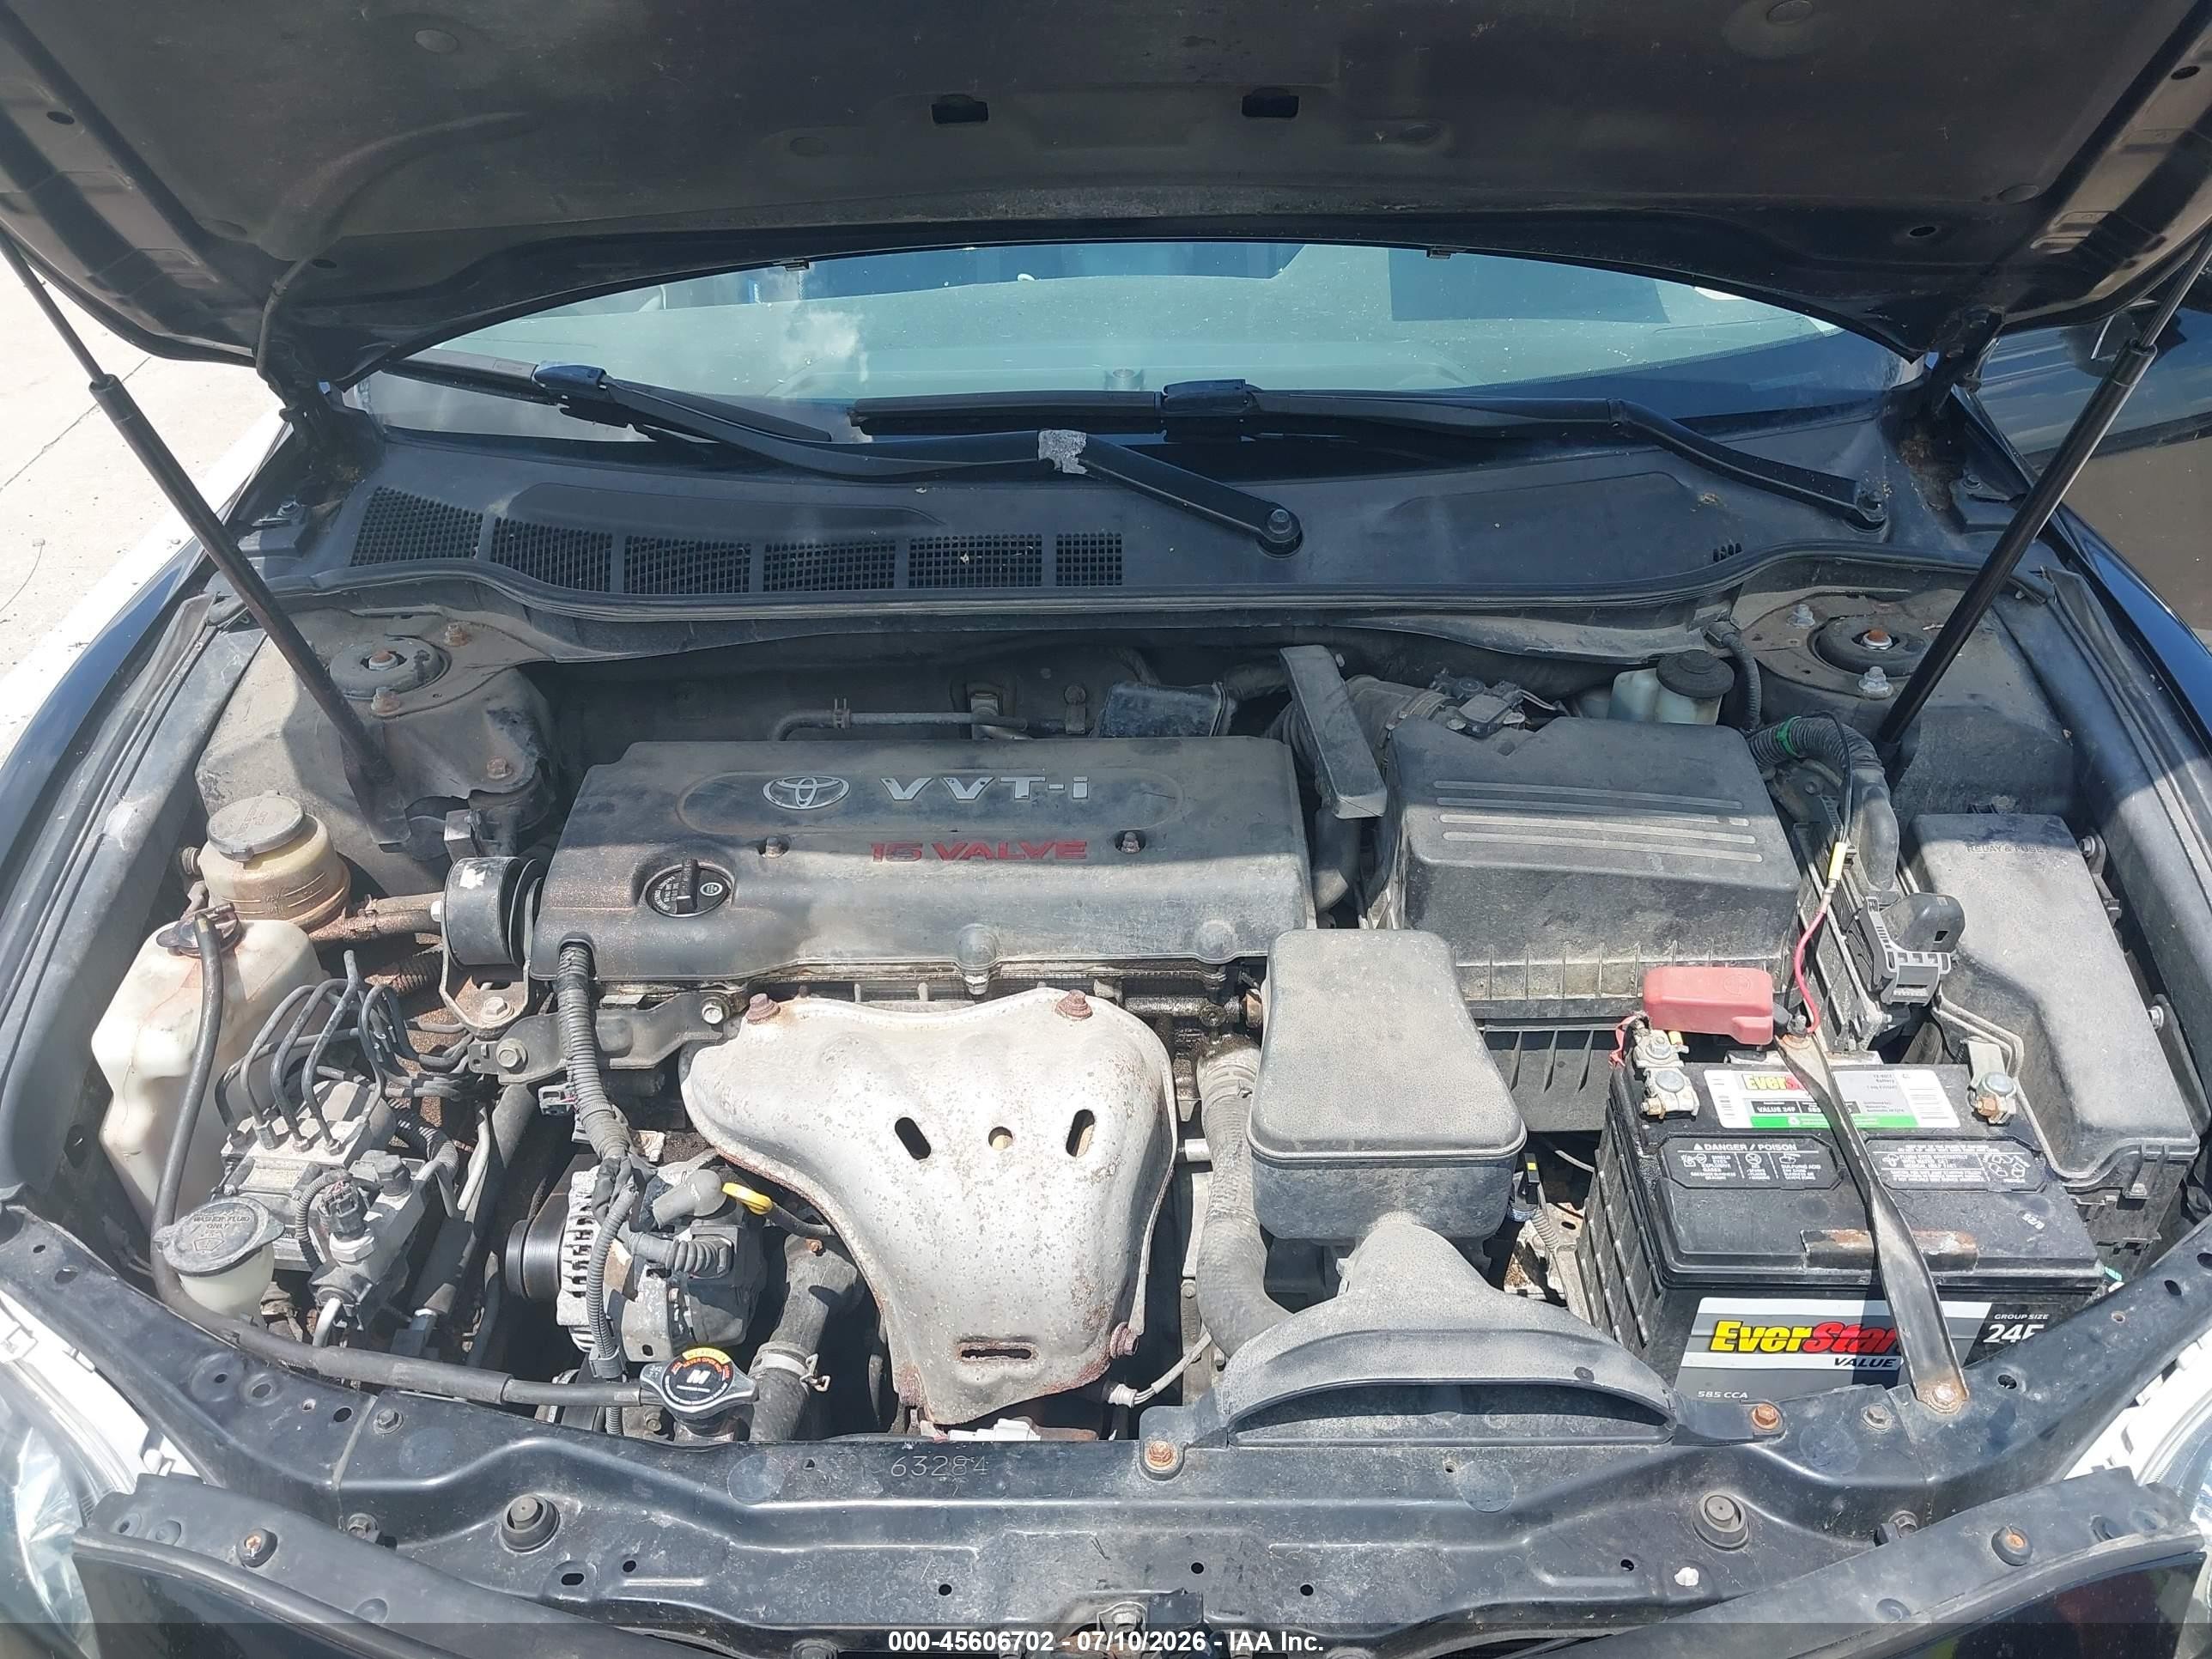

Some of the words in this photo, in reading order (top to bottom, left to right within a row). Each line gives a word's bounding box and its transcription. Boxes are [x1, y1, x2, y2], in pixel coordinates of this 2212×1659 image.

[880, 776, 1089, 800] VVT-i
[871, 842, 923, 863] 16
[932, 841, 1088, 861] VALVE
[1966, 844, 2002, 853] RELAY
[2004, 844, 2012, 853] &
[1710, 1320, 1900, 1353] EverStar
[1834, 1358, 1897, 1368] VALUE
[890, 1455, 988, 1477] 63284
